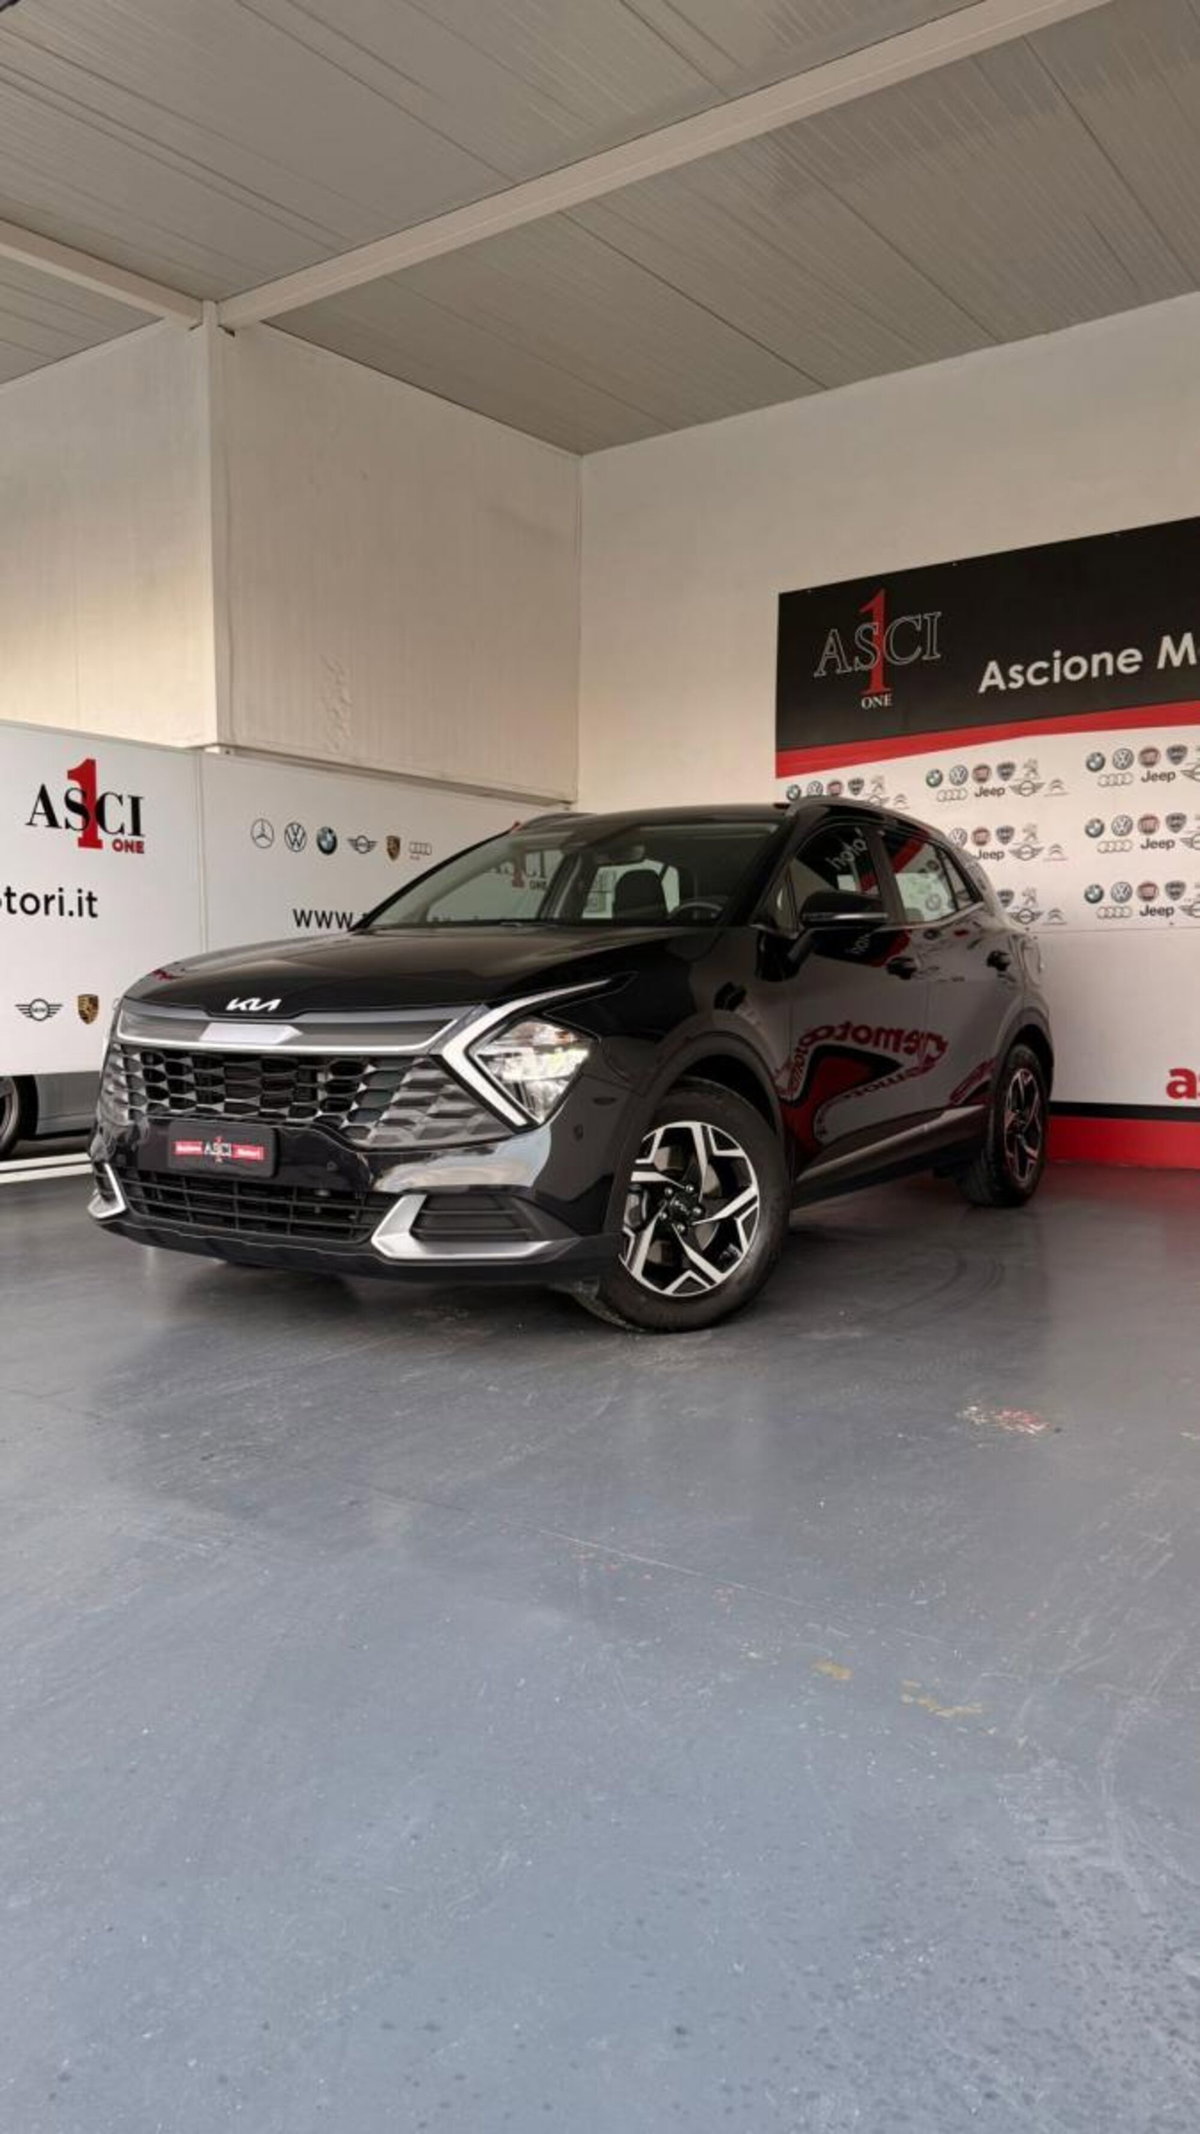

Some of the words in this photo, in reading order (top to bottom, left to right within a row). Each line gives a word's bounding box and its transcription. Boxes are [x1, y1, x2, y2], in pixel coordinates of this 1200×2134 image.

[813, 611, 942, 678] ASCI
[977, 648, 1144, 694] Ascione
[1156, 632, 1200, 670] M
[860, 693, 894, 710] ONE
[1140, 770, 1176, 783] Jeep
[974, 786, 1006, 798] Jeep
[25, 783, 146, 837] ASCI
[111, 839, 145, 854] ONE
[1140, 838, 1176, 851] Jeep
[974, 849, 1005, 861] Jeep
[0, 886, 99, 918] tori.it
[1139, 904, 1175, 917] Jeep
[225, 997, 282, 1012] KIA
[1166, 1067, 1200, 1100] a
